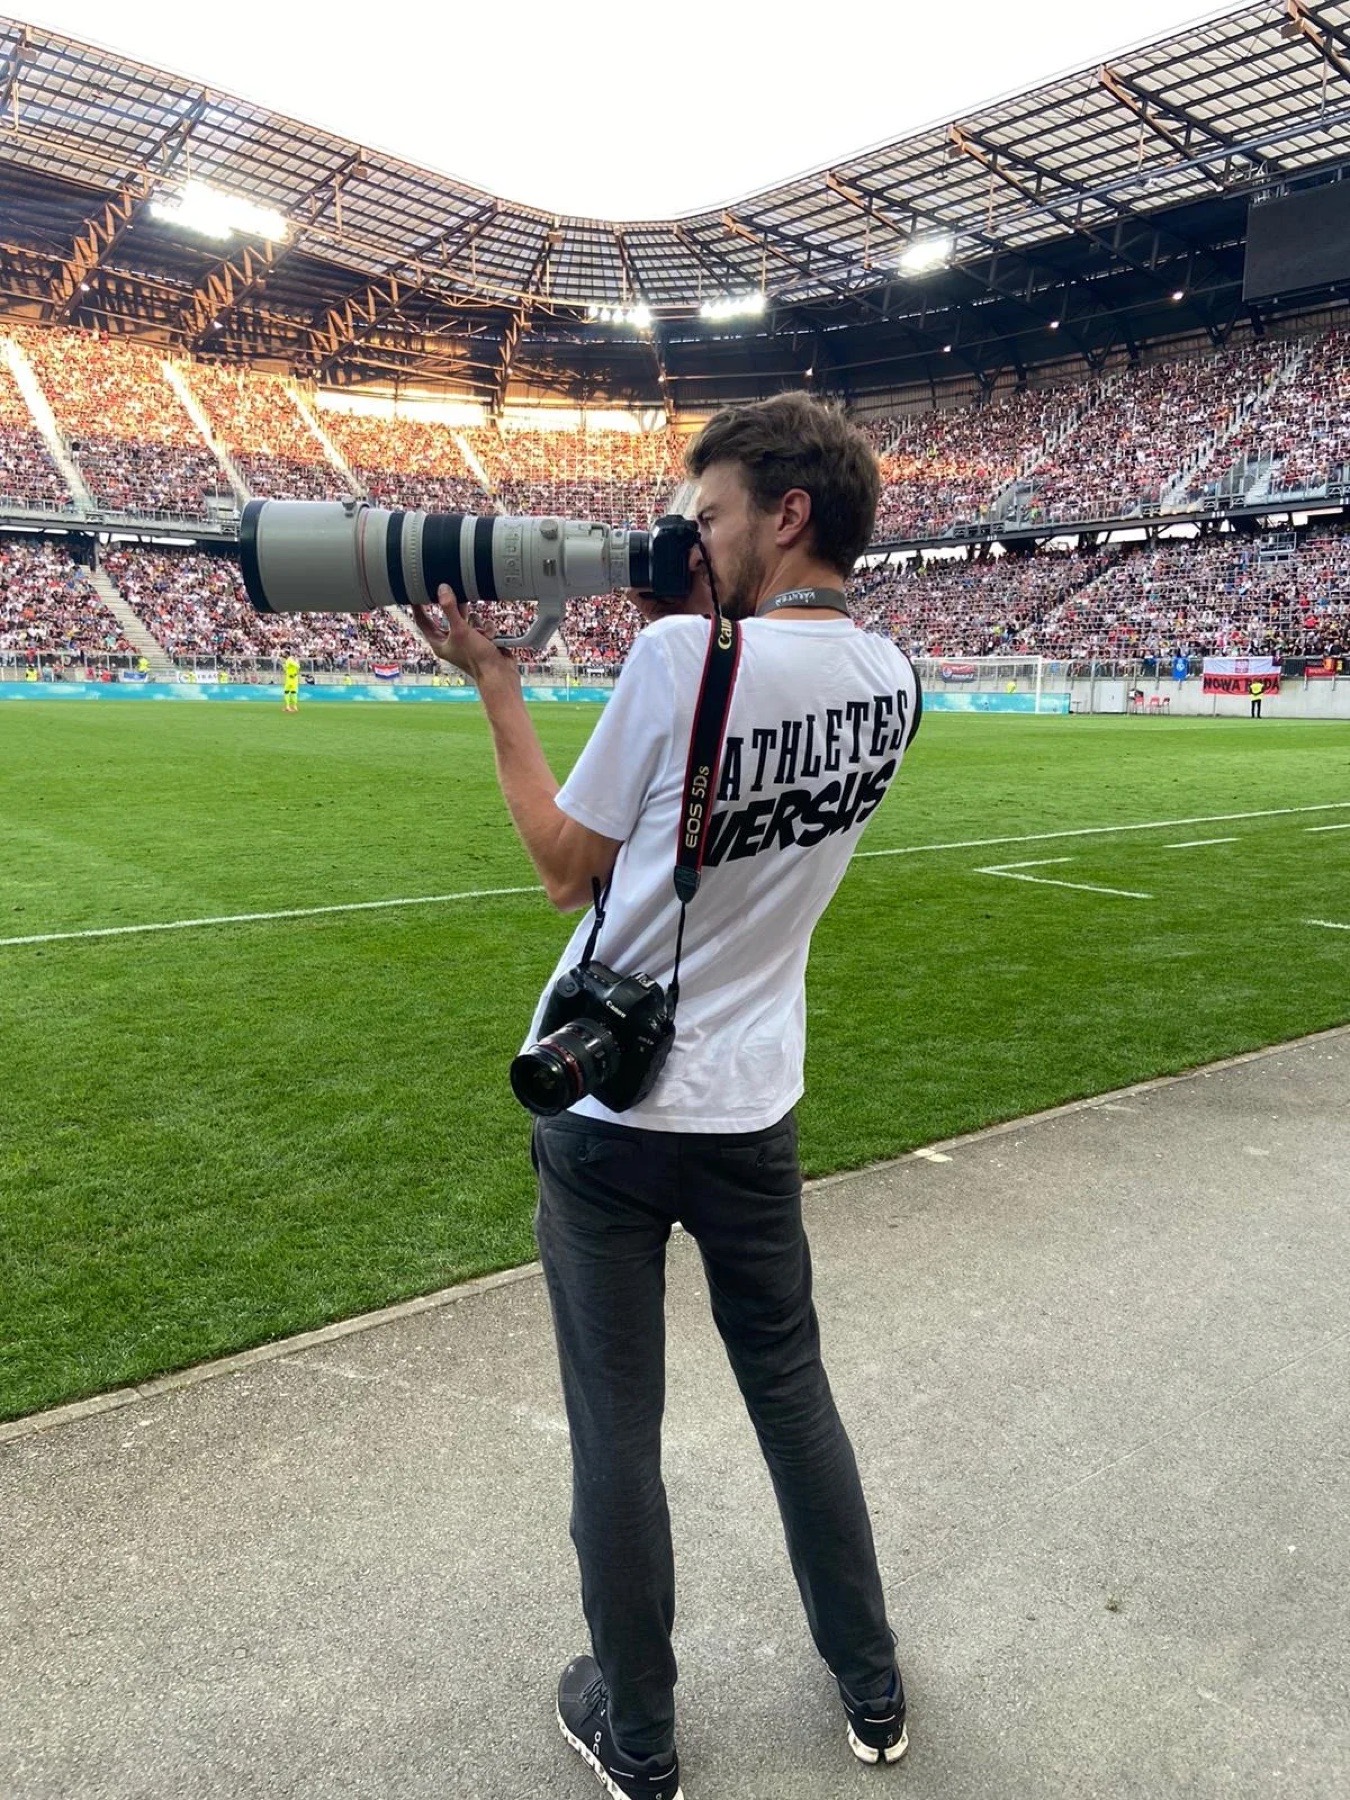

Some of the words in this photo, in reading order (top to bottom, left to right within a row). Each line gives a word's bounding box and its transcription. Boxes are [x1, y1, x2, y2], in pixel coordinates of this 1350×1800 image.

[718, 617, 733, 650] Can
[1203, 677, 1241, 691] NOWA
[1244, 677, 1280, 691] RDA
[717, 690, 908, 801] ATHLETES
[685, 802, 703, 849] EOS
[701, 758, 898, 867] VERSUS
